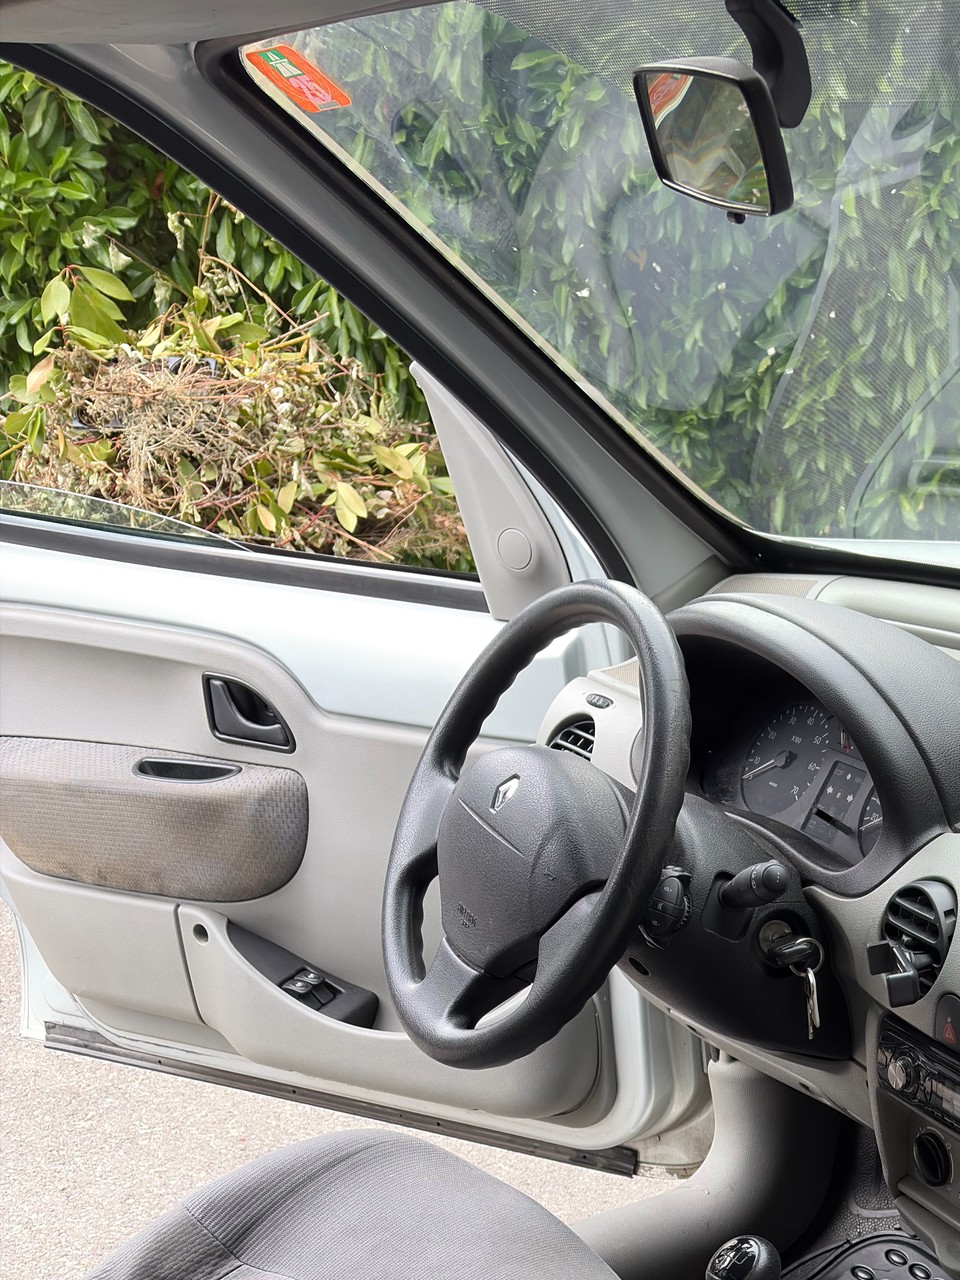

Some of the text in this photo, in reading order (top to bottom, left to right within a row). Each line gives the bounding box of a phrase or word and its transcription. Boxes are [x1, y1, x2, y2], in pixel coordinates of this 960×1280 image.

[288, 75, 332, 105] 25
[788, 716, 797, 725] 30
[806, 716, 815, 726] 40
[768, 730, 777, 740] 20
[812, 735, 822, 745] 50
[807, 762, 817, 771] 60
[790, 785, 800, 794] 70
